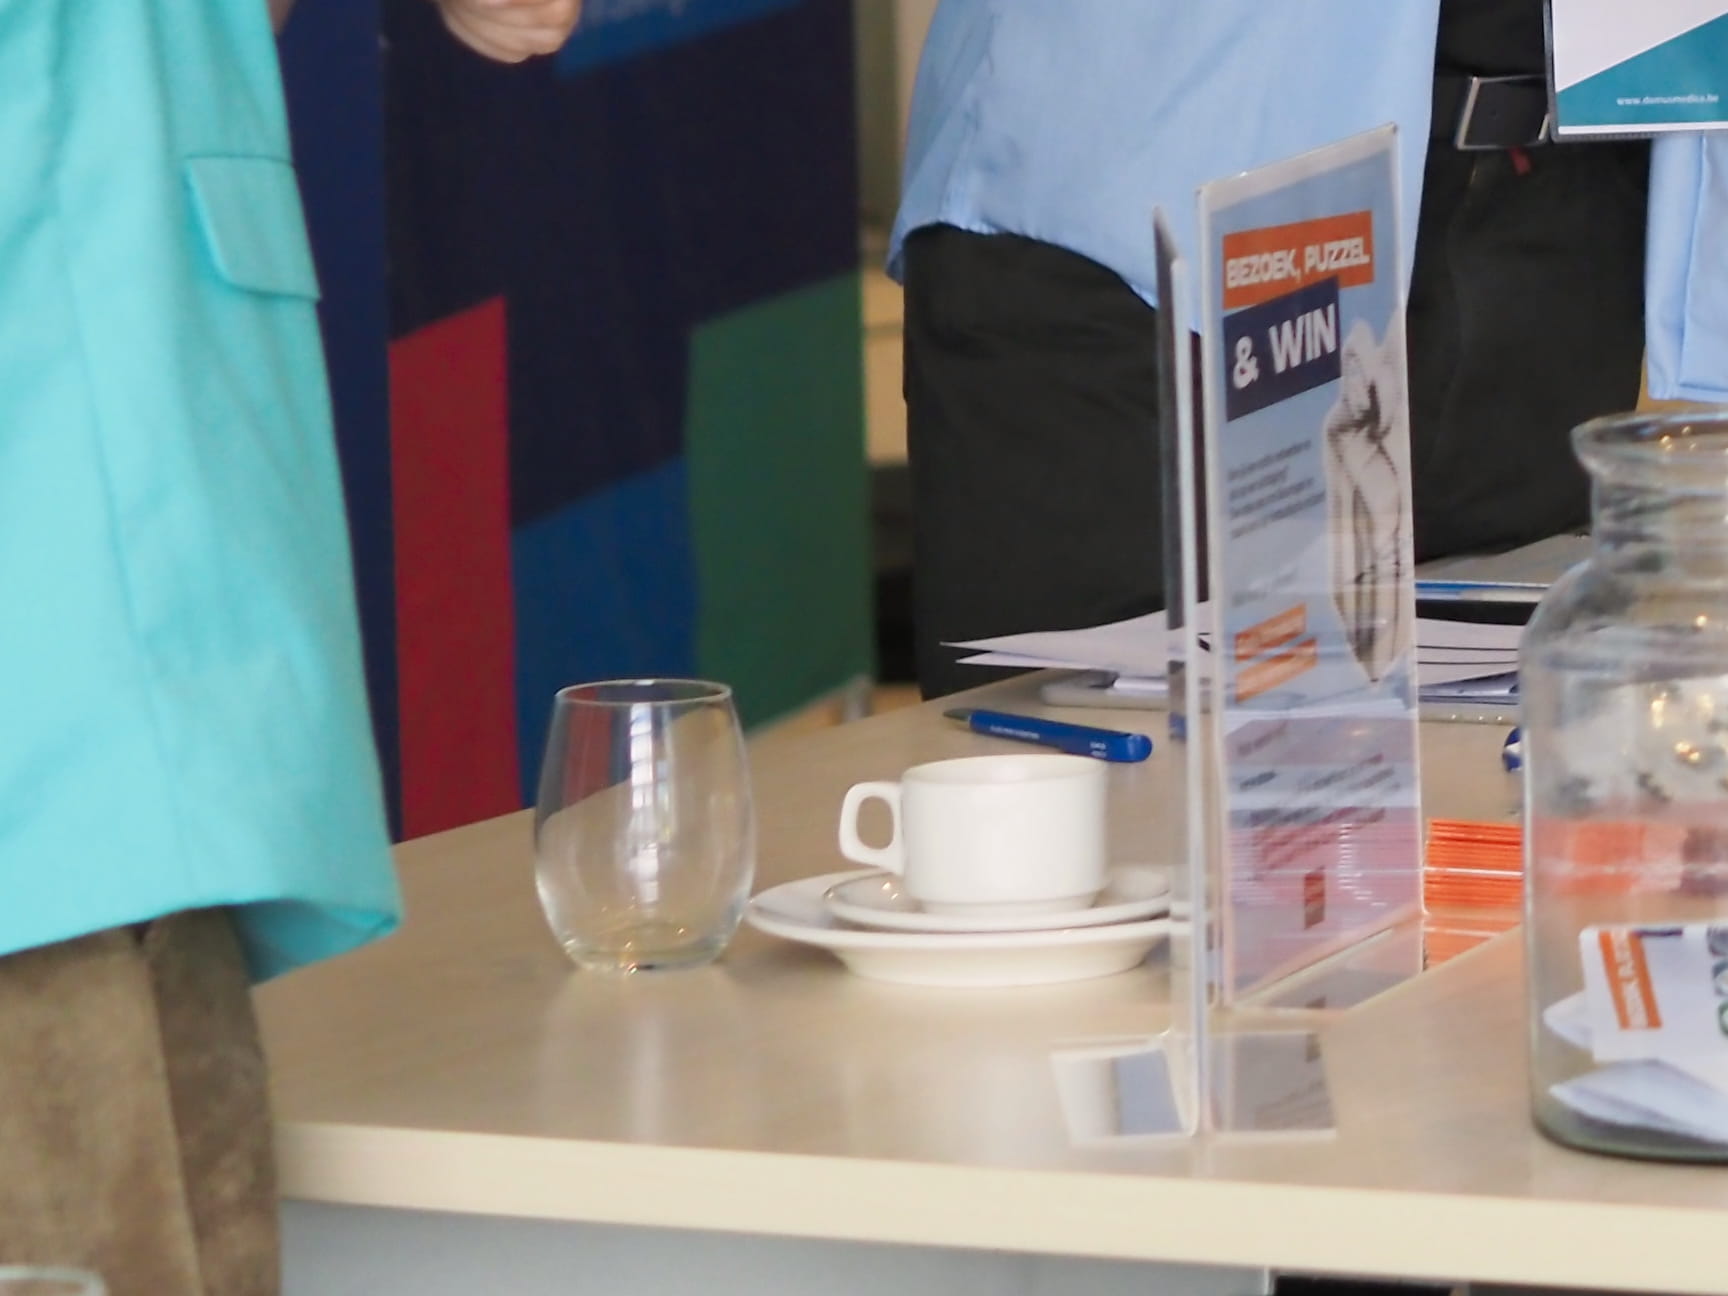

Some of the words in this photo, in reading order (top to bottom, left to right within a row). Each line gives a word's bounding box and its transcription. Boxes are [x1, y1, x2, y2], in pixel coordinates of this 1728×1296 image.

[1226, 248, 1301, 289] BEZOEK,
[1304, 236, 1371, 274] PUZZEL
[1232, 335, 1260, 391] &
[1268, 302, 1337, 375] WIN
